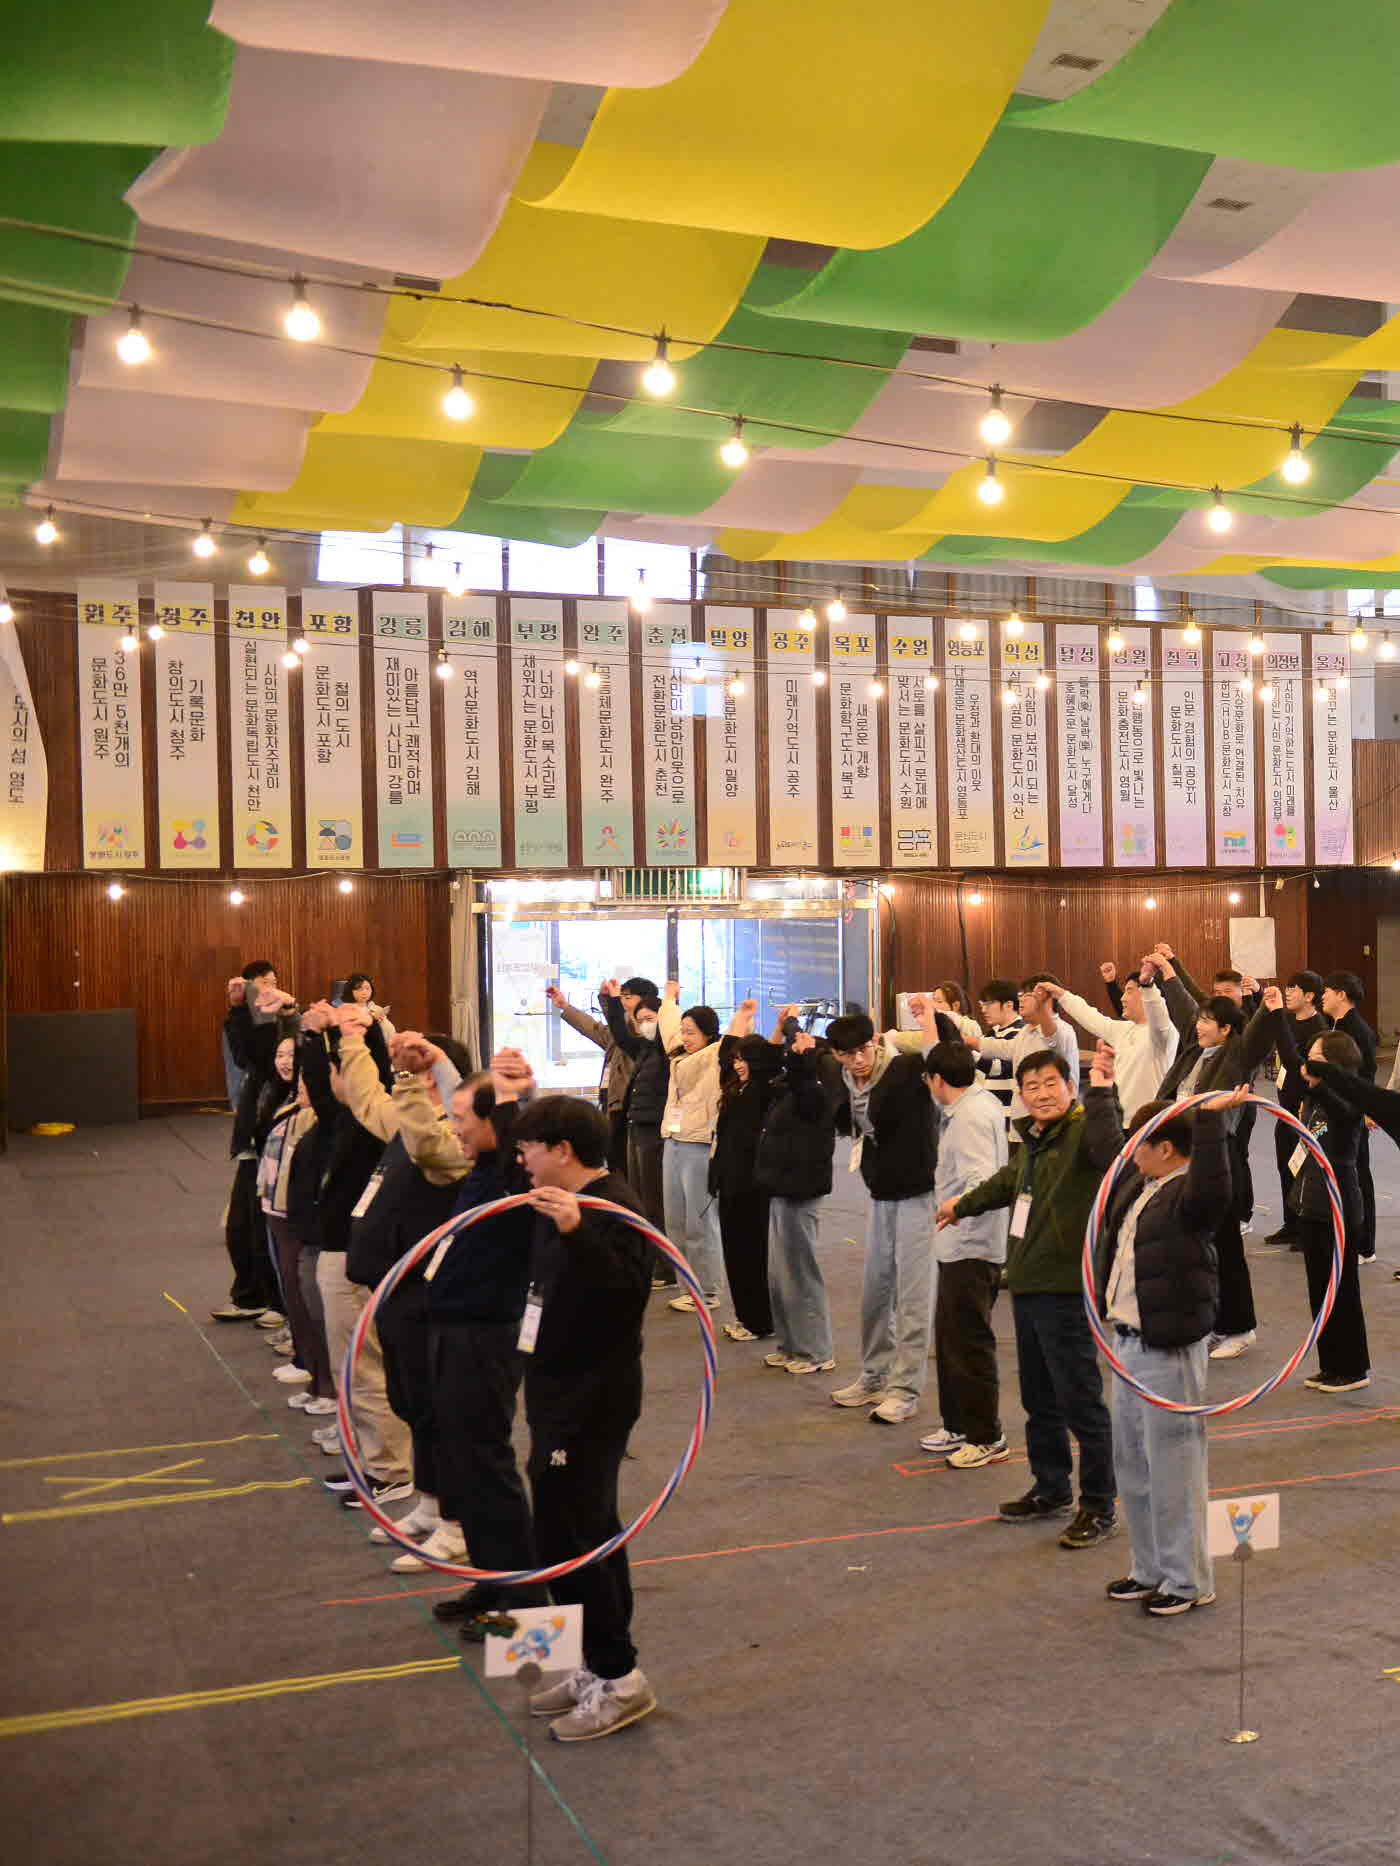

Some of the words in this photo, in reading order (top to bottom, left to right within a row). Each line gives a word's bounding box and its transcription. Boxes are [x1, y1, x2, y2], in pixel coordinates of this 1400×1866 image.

[84, 603, 131, 624] 원주
[160, 607, 208, 626] 청주
[235, 610, 281, 630] 천안
[309, 614, 353, 633] 포항
[380, 617, 422, 636] 강릉
[449, 620, 490, 638] 김해
[517, 623, 557, 640] 부평
[583, 624, 624, 642] 완주
[649, 628, 686, 645] 춘천
[711, 630, 749, 648] 밀양
[774, 632, 808, 650] 공주
[834, 636, 870, 653] 목포
[893, 639, 927, 657] 수원
[948, 640, 984, 656] 영등포
[1005, 643, 1038, 661] 익산
[1059, 647, 1093, 663] 달성
[1113, 648, 1145, 664] 영월
[1167, 651, 1198, 666] 칠곡
[244, 641, 257, 694] 실현되는
[1218, 652, 1248, 668] 고창
[1267, 655, 1299, 669] 의정부
[1316, 655, 1345, 671] 울산
[92, 657, 108, 721] 문화도시
[168, 660, 184, 723] 창의도시
[264, 663, 277, 704] 시민의
[316, 665, 330, 728] 문화도시
[335, 682, 349, 712] 철의
[385, 657, 400, 717] 재미있는
[405, 668, 419, 728] 아름답고
[522, 655, 536, 714] 채워지는
[540, 670, 553, 699] 너와
[670, 667, 683, 711] 시민이
[897, 675, 910, 716] 맞서는
[913, 675, 925, 717] 서로를
[189, 680, 206, 742] 기록문화
[464, 670, 479, 760] 역사문화도시
[653, 674, 666, 762] 전환문화도시
[970, 694, 981, 728] 우정과
[1025, 687, 1037, 726] 사람이
[1184, 691, 1194, 716] 인문
[336, 719, 350, 748] 도시
[541, 706, 554, 734] 나의
[786, 680, 799, 765] 미래기억도시
[839, 682, 853, 767] 문화항구도시
[856, 704, 868, 746] 새로운
[1171, 706, 1182, 759] 문화도시
[93, 728, 109, 759] 원주
[115, 704, 130, 768] 5천개의
[169, 729, 185, 761] 청주
[246, 700, 259, 780] 문화독립도시
[265, 709, 279, 789] 문화자주권이
[317, 733, 332, 764] 포항
[387, 724, 401, 769] 시나미
[523, 720, 537, 779] 문화도시
[899, 722, 912, 777] 문화도시
[914, 722, 926, 761] 살피고
[970, 732, 982, 766] 환대의
[1184, 723, 1196, 761] 경험의
[406, 734, 421, 795] 쾌적하며
[857, 751, 869, 779] 개항
[1012, 735, 1024, 788] 문화도시
[1026, 733, 1038, 773] 보석이
[1066, 733, 1077, 781] 문화도시
[1272, 746, 1282, 787] 문화도시
[1328, 731, 1338, 781] 문화도시
[466, 766, 480, 796] 김해
[542, 739, 555, 799] 목소리로
[655, 768, 668, 797] 춘천
[725, 769, 737, 798] 밀양
[971, 771, 982, 792] 이웃
[1171, 764, 1183, 789] 칠곡
[1286, 761, 1295, 783] 도시
[248, 785, 260, 812] 천안
[388, 775, 403, 805] 강릉
[525, 785, 539, 814] 부평
[600, 775, 614, 802] 완주
[787, 771, 800, 799] 공주
[841, 772, 854, 800] 목포
[900, 782, 912, 809] 수원
[914, 768, 927, 809] 문제에
[1027, 779, 1038, 804] 되는
[1067, 784, 1078, 809] 달성
[1080, 755, 1093, 814] 누구에게나
[1119, 776, 1130, 802] 영월
[1133, 769, 1144, 809] 빛나는
[1185, 766, 1197, 805] 공유지
[1328, 786, 1338, 811] 울산
[957, 785, 968, 820] 영등포
[1012, 794, 1024, 820] 익산
[1222, 795, 1232, 817] 고창
[1273, 791, 1282, 822] 의정부
